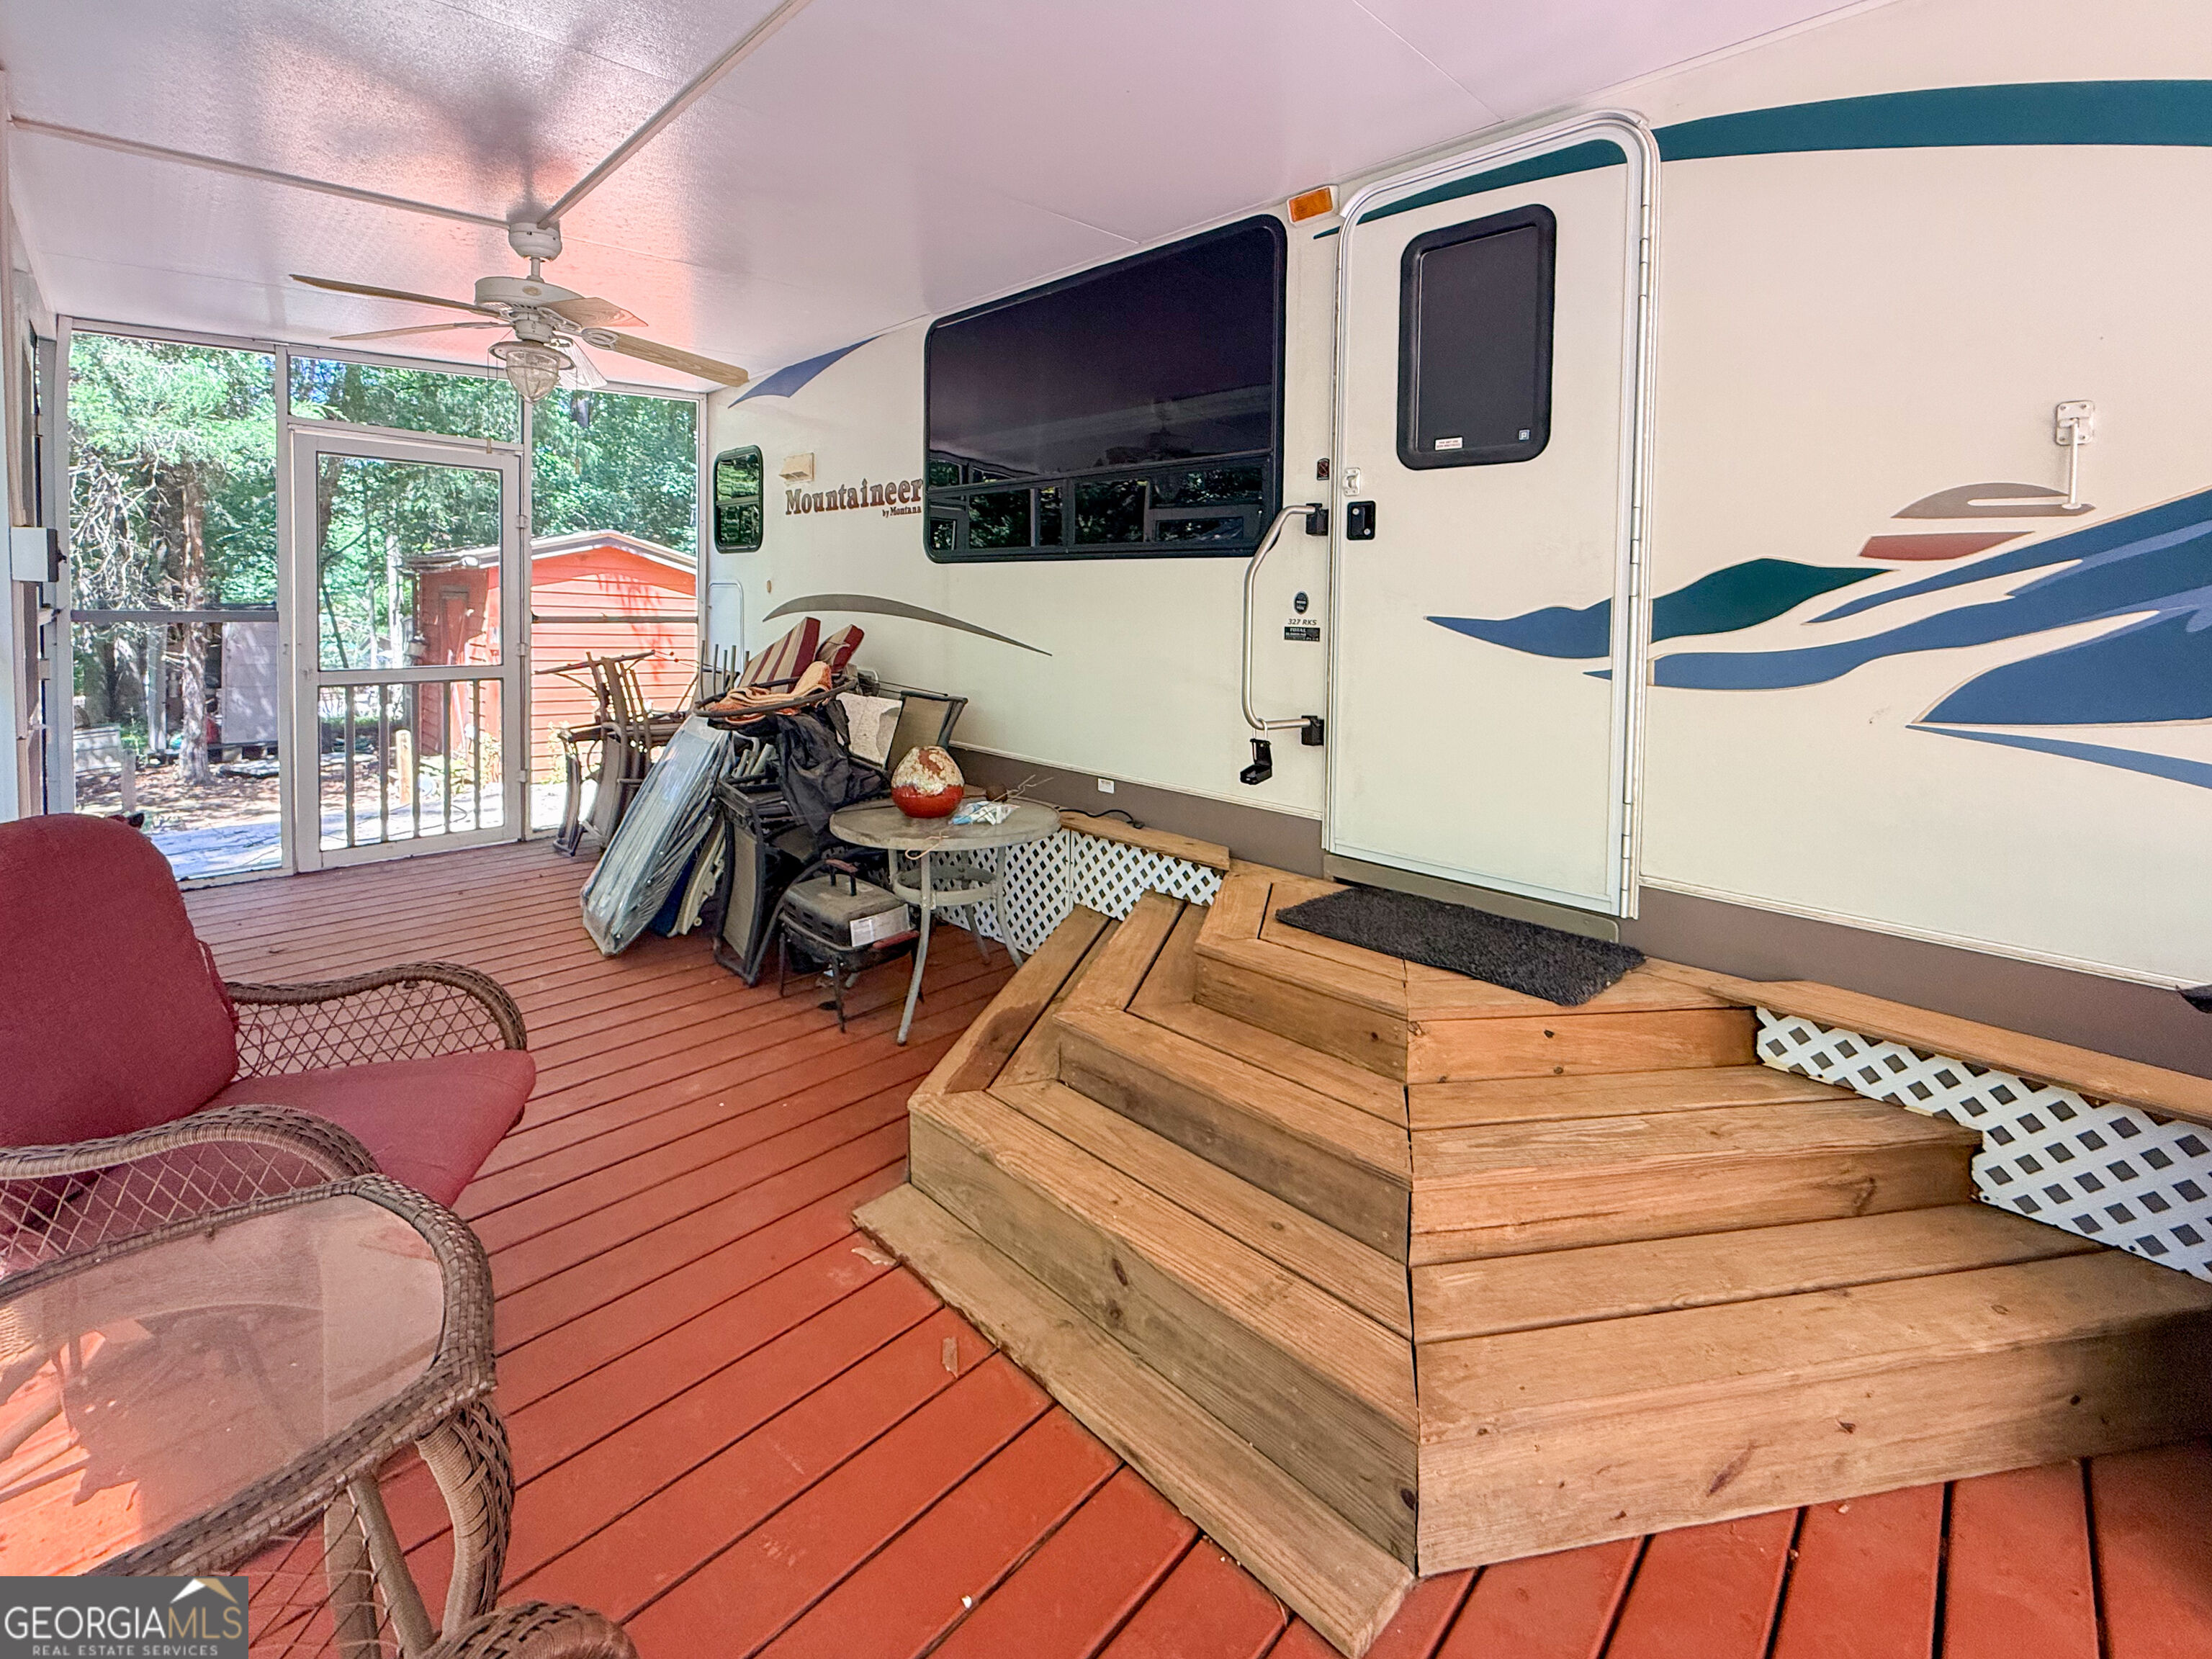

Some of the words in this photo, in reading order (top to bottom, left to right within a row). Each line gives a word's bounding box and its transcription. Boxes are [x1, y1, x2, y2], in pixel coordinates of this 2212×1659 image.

[786, 478, 923, 515] Mountaineer
[882, 509, 889, 518] by
[890, 505, 922, 516] Montana
